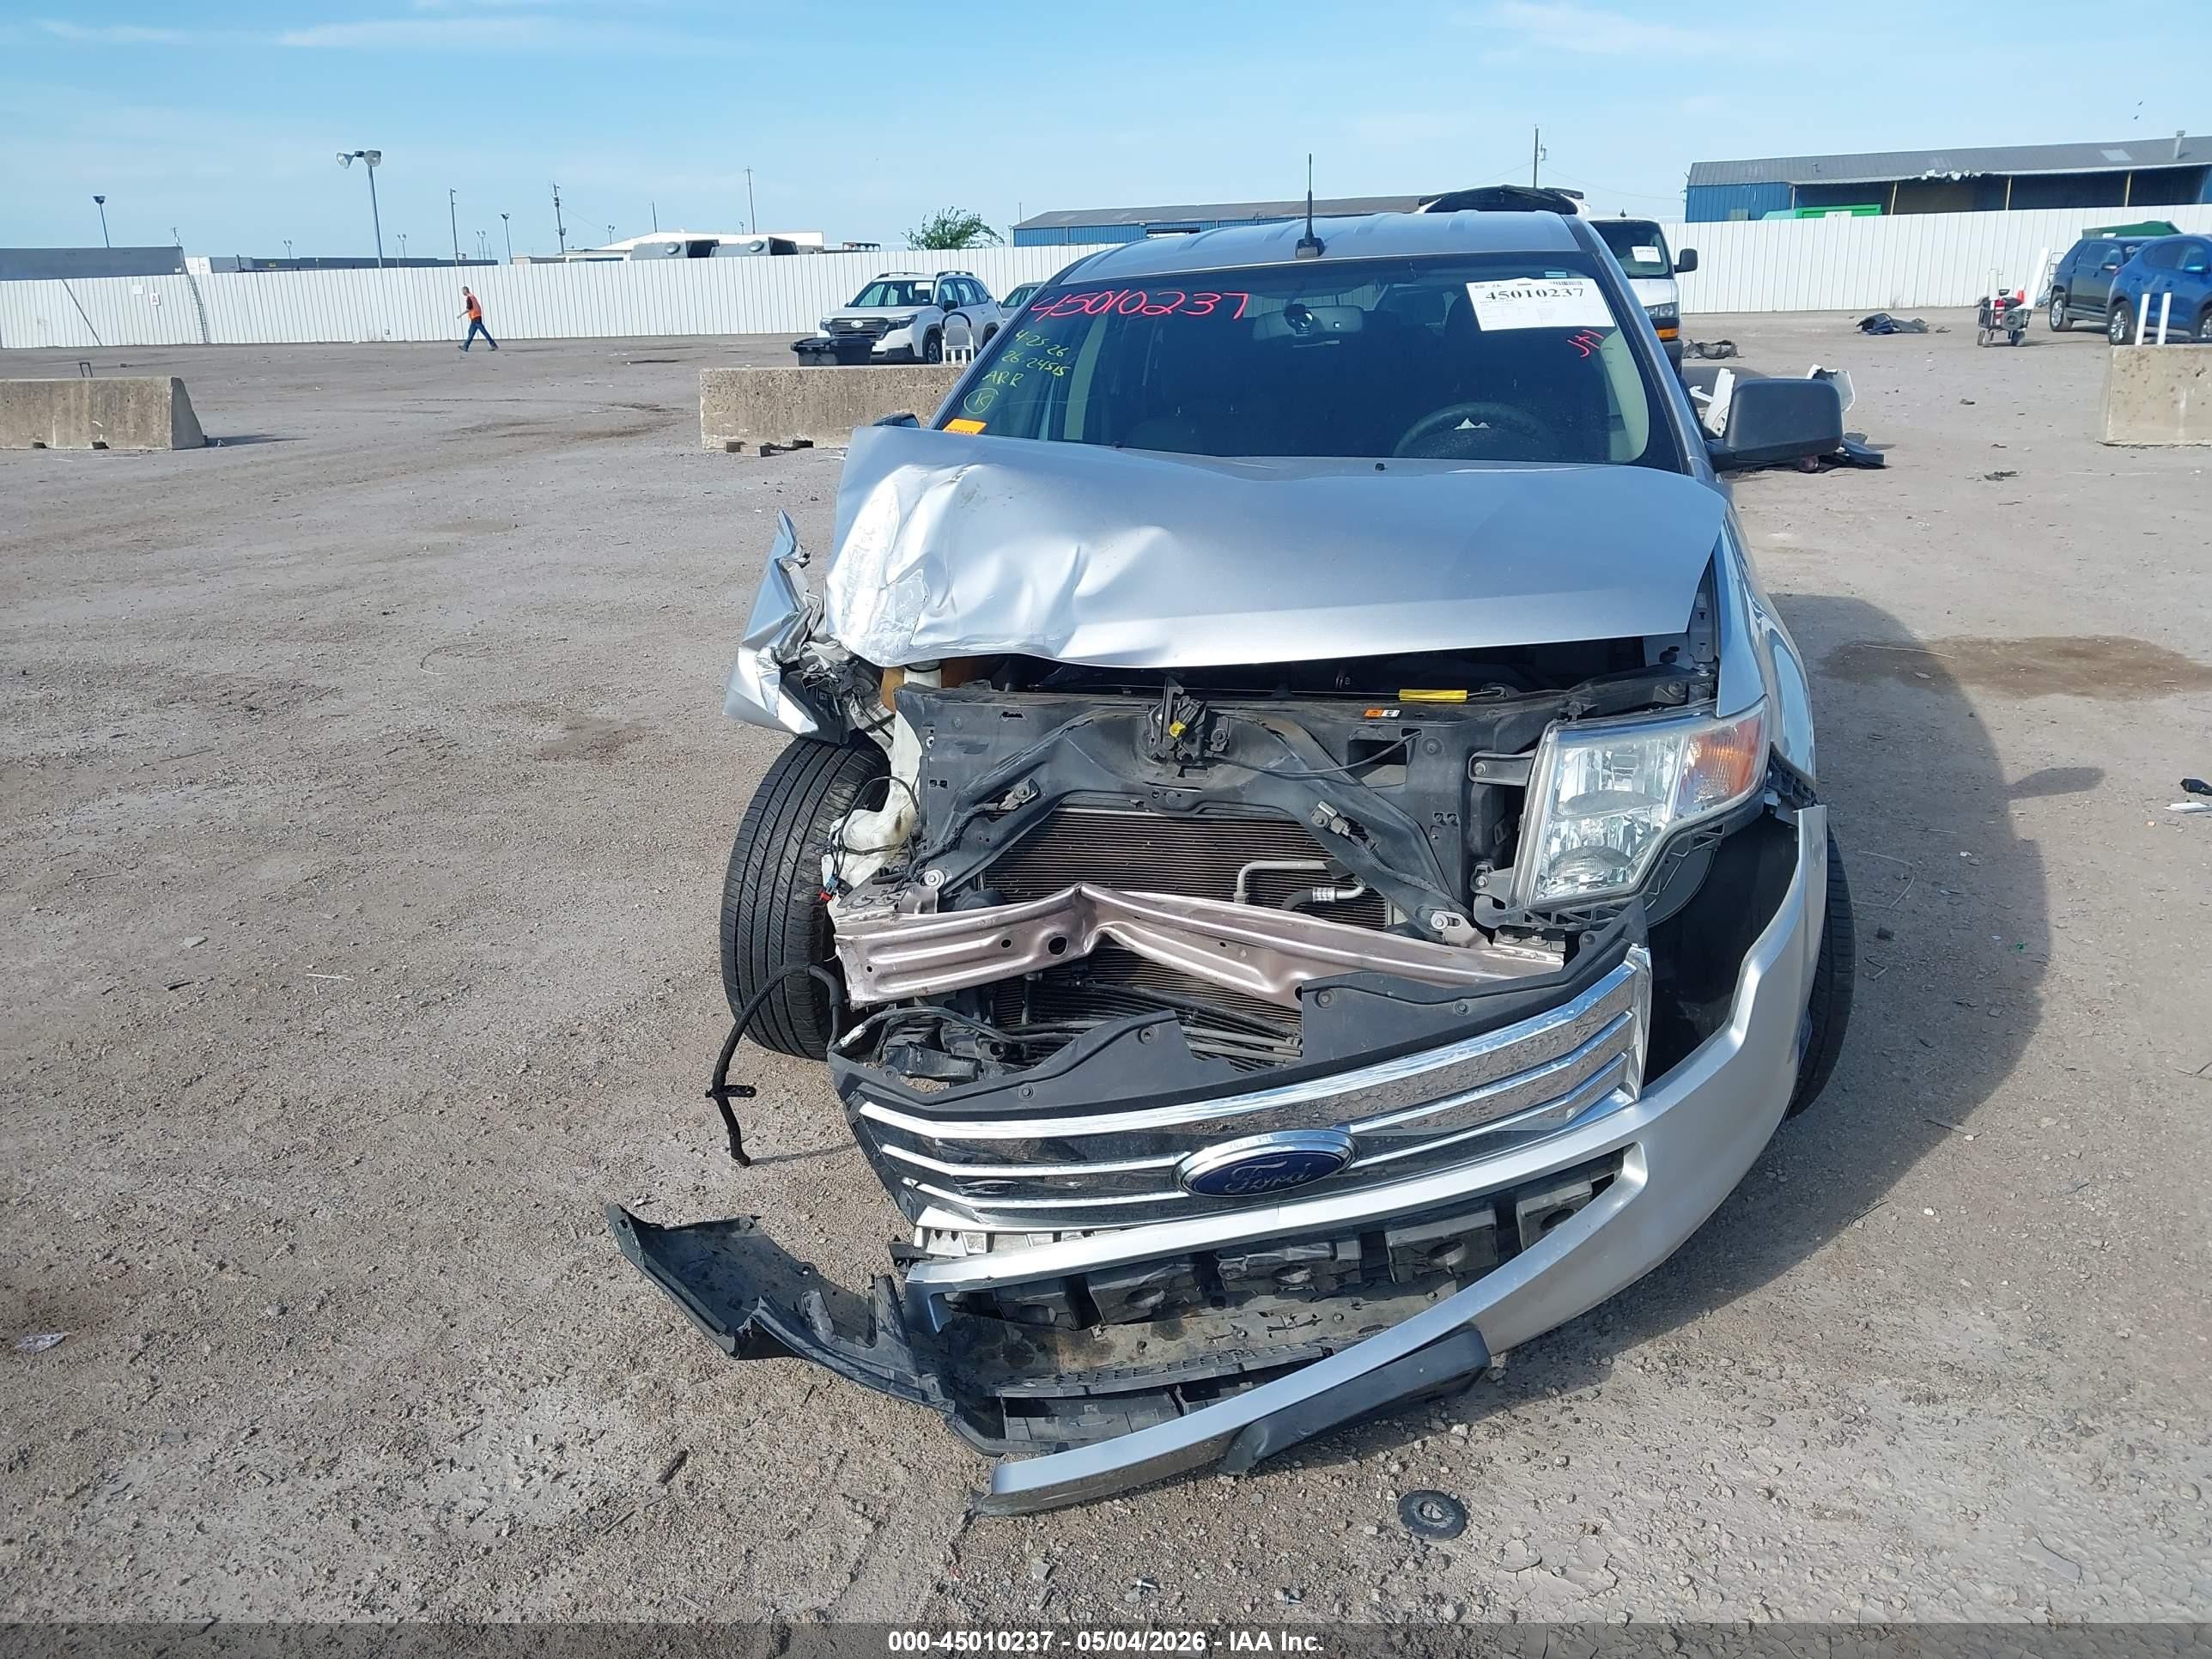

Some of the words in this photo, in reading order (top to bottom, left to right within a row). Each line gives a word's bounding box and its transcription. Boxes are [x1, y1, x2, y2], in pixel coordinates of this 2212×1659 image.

[1030, 289, 1249, 322] 45010237
[1485, 288, 1584, 301] 45010237
[1015, 329, 1070, 357] 4-25-26
[1224, 1161, 1312, 1193] Ford
